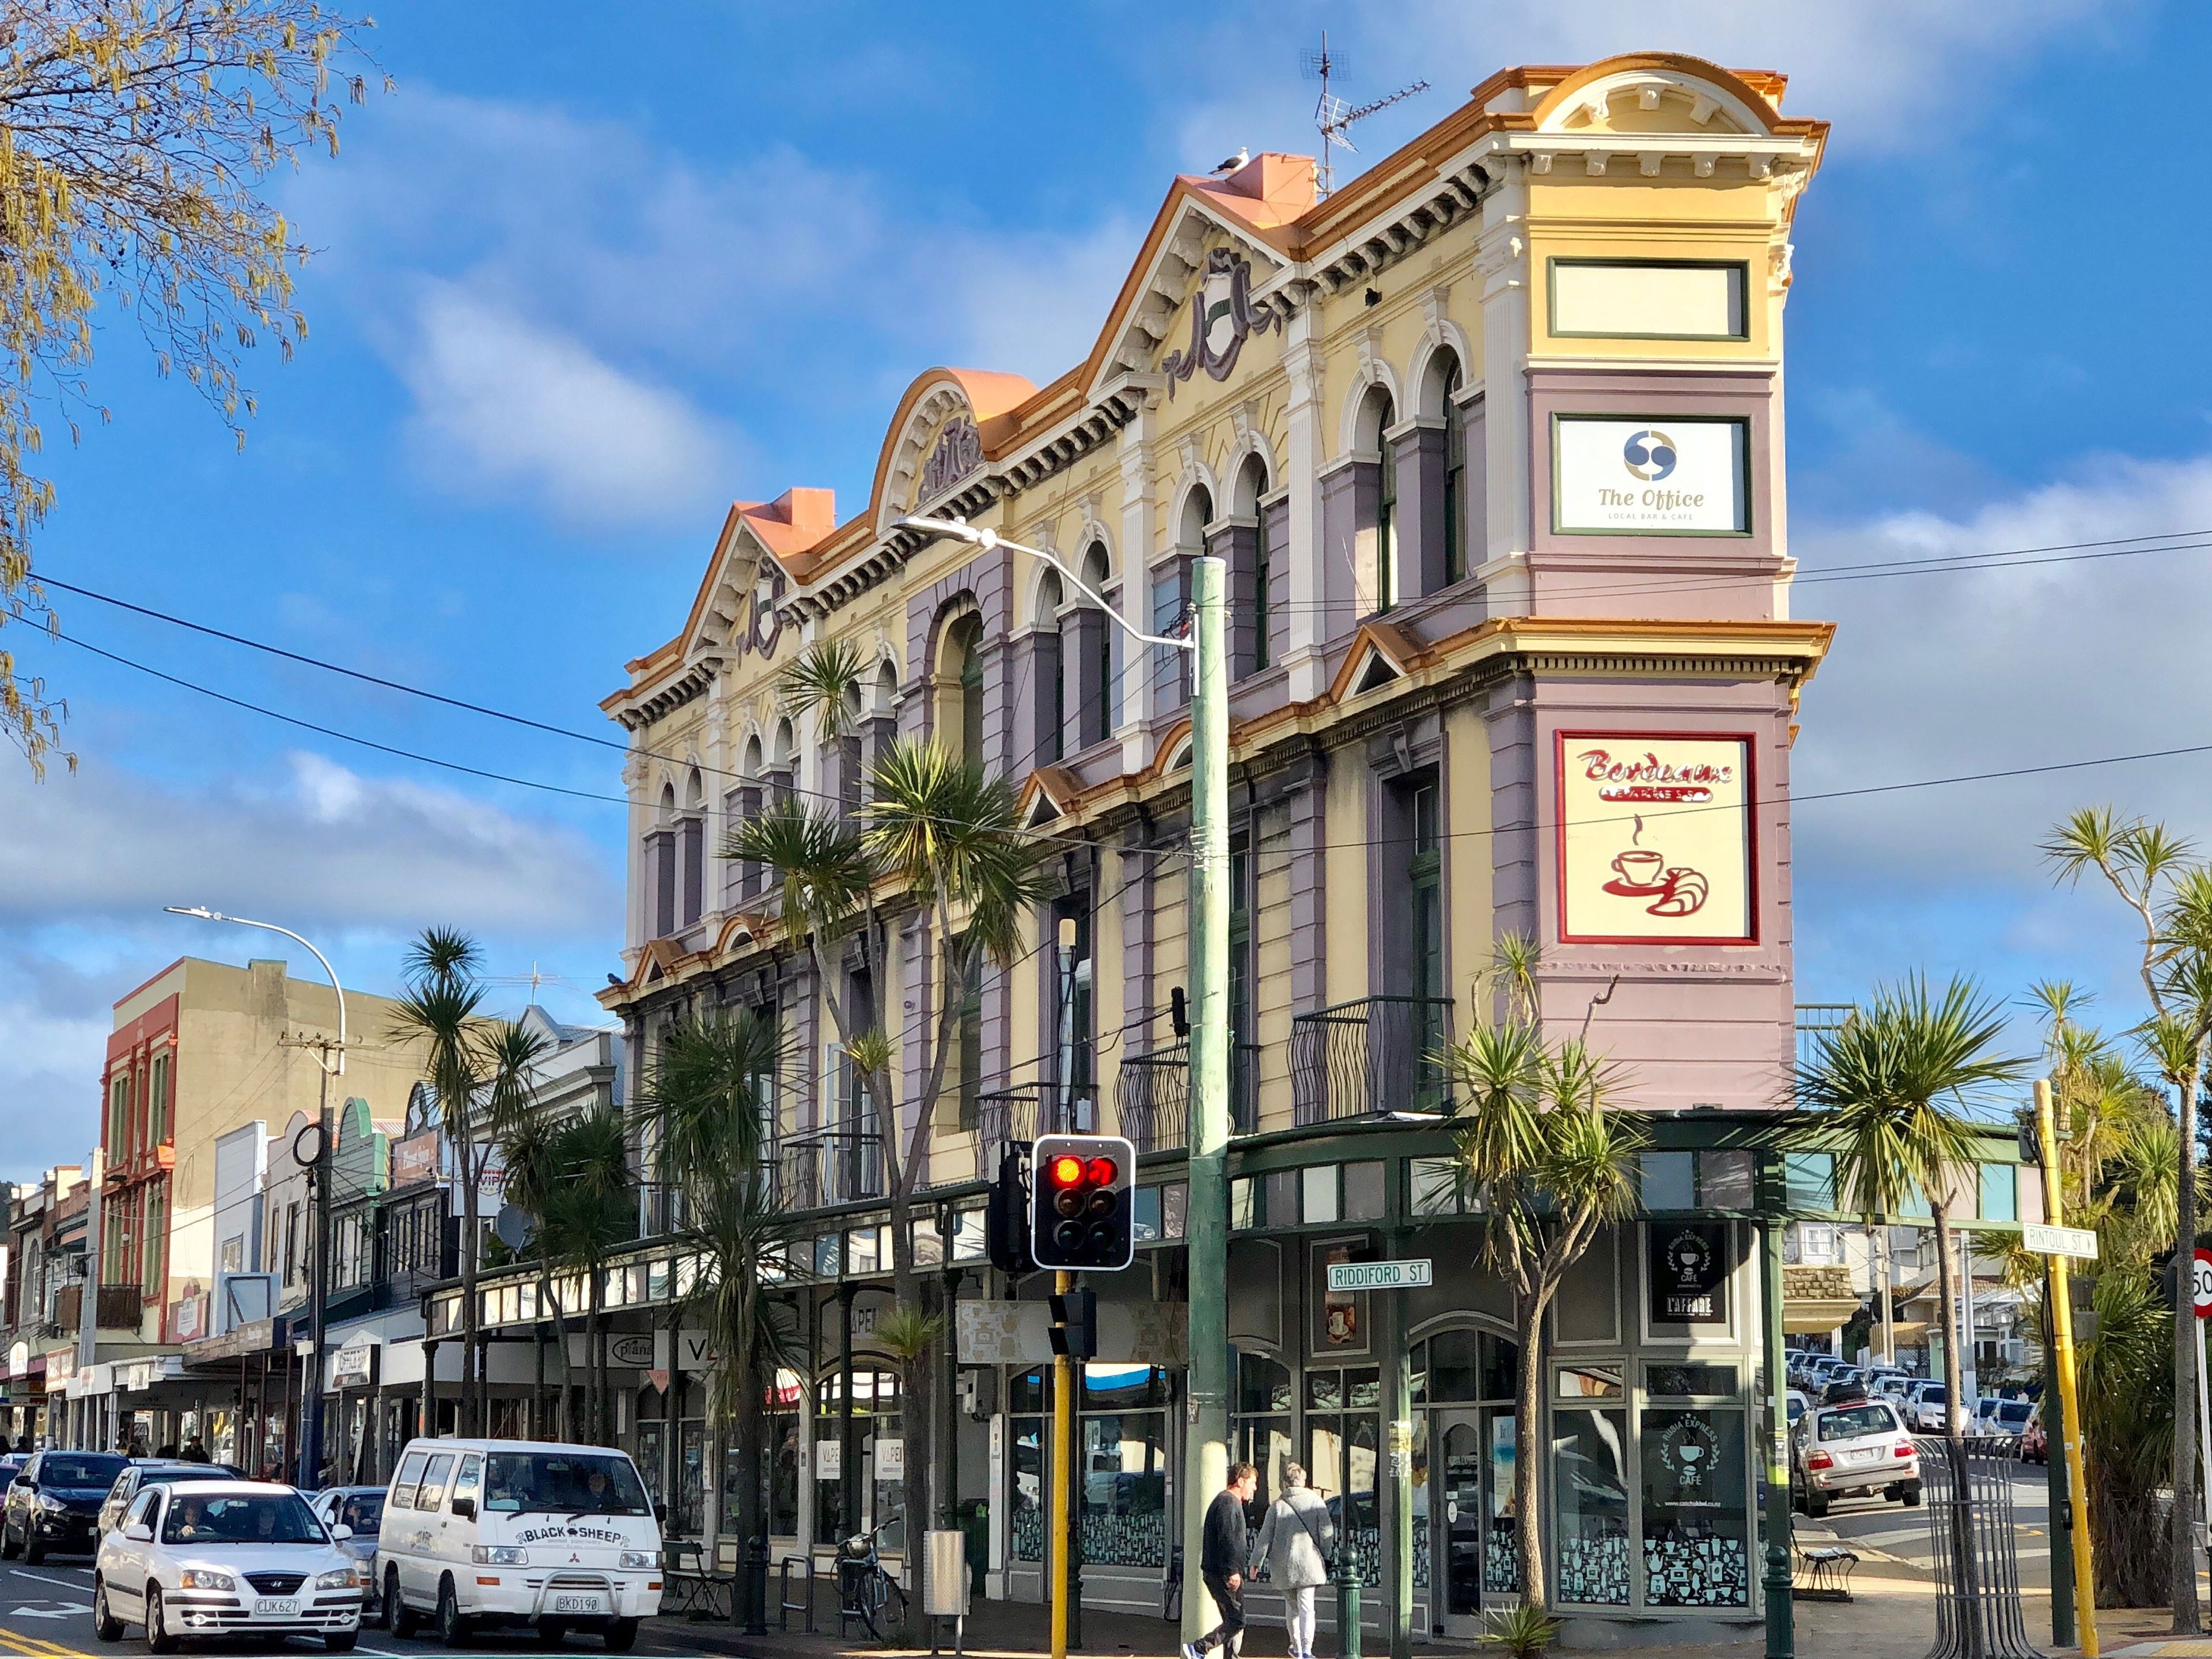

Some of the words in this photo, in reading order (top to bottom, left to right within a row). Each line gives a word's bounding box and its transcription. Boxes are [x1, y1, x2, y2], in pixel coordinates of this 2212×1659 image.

[1599, 489, 1634, 506] The
[1642, 489, 1704, 510] Office
[2029, 1229, 2067, 1249] RINTOUL
[2072, 1234, 2082, 1251] ST
[1335, 1266, 1400, 1285] RIDDIFORD
[1410, 1264, 1423, 1281] ST
[1662, 1421, 1684, 1441] RUBIA
[1685, 1419, 1718, 1442] EXPRESS
[1679, 1474, 1702, 1485] CAFÉ
[524, 1527, 566, 1542] BLACK
[579, 1527, 621, 1543] SHEEP
[257, 1601, 298, 1612] CUK627
[559, 1598, 597, 1610] BKD190
